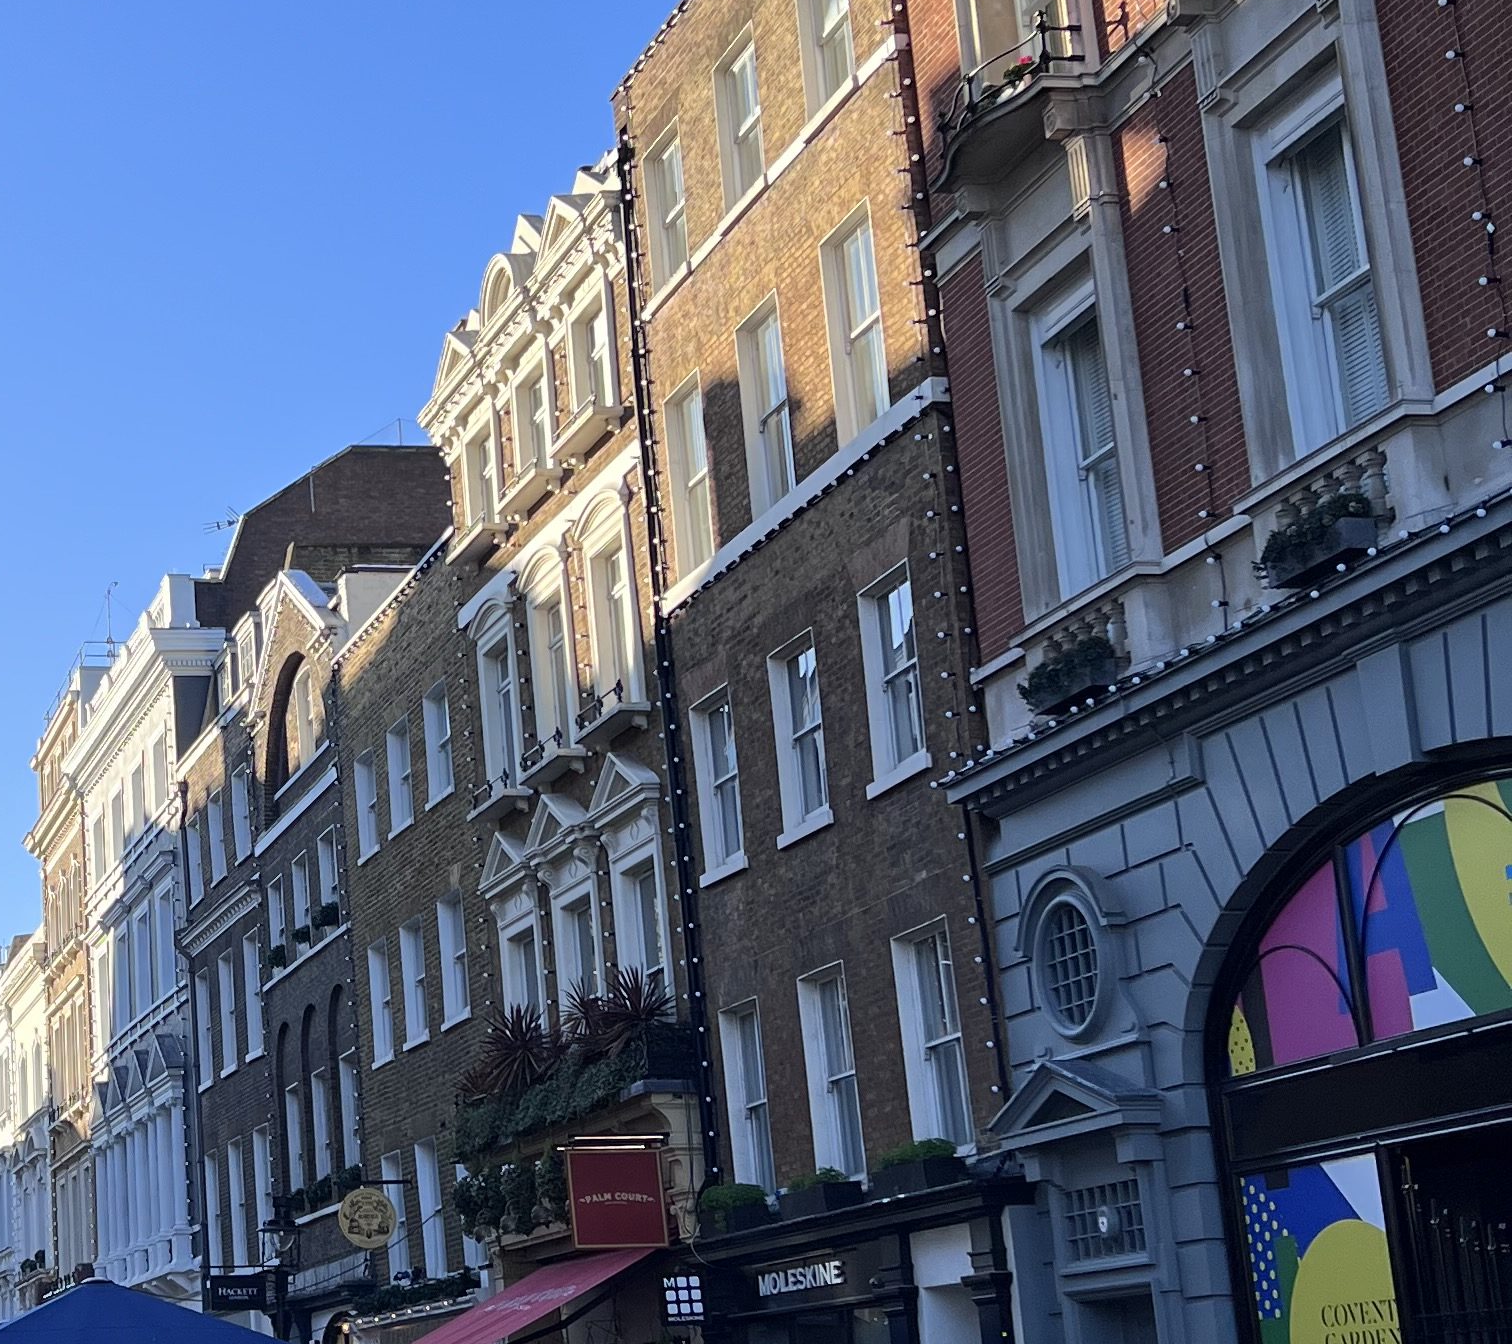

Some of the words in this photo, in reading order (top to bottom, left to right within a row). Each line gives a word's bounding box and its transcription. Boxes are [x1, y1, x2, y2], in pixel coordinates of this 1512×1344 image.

[585, 1193, 612, 1204] PALM
[614, 1192, 649, 1203] COURT
[663, 1277, 676, 1288] M
[758, 1261, 845, 1297] MOLESKINE
[218, 1287, 258, 1296] HACKETT
[1321, 1299, 1397, 1328] COVENT
